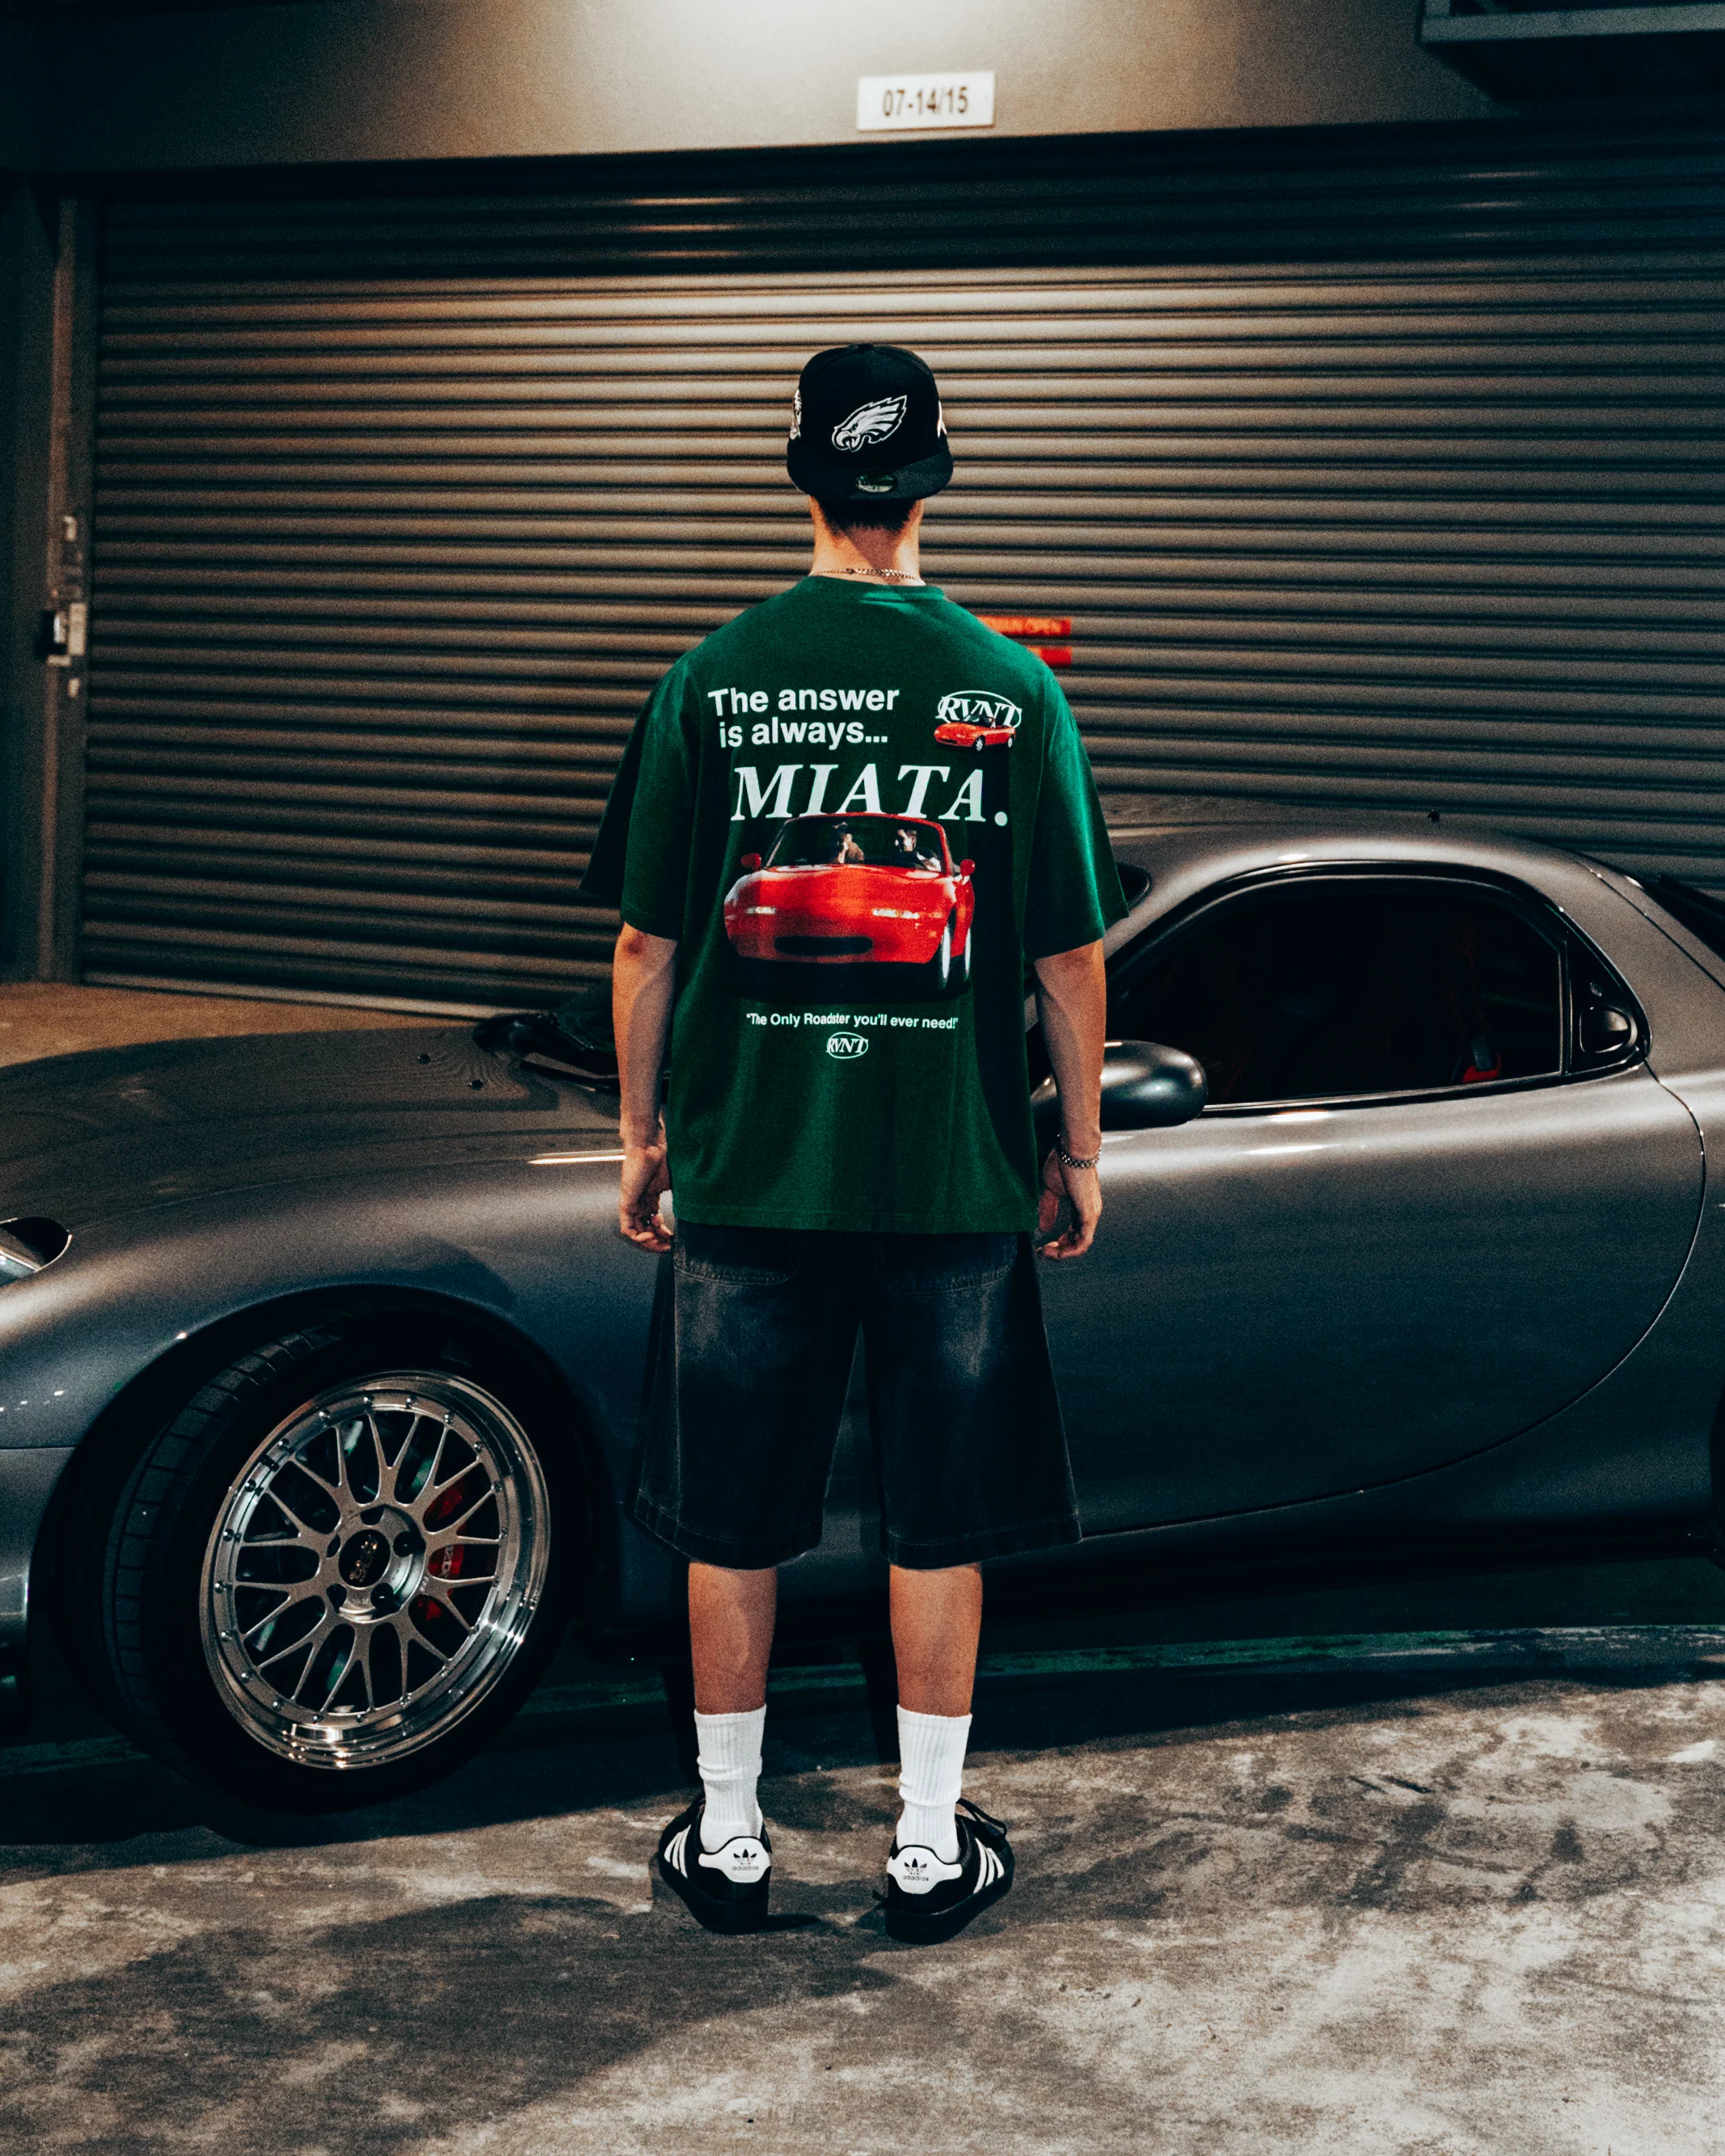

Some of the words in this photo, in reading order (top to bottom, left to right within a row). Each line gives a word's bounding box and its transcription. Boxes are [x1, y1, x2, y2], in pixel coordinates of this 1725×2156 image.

[883, 85, 968, 118] 07-14/15
[708, 688, 770, 716] The
[778, 689, 899, 711] answer
[720, 722, 742, 748] is
[752, 717, 888, 750] always...
[731, 764, 1007, 825] MIATA.
[770, 1013, 800, 1027] Only
[804, 1012, 850, 1025] Roadster
[891, 1016, 919, 1027] ever
[826, 1038, 869, 1053] RVNT
